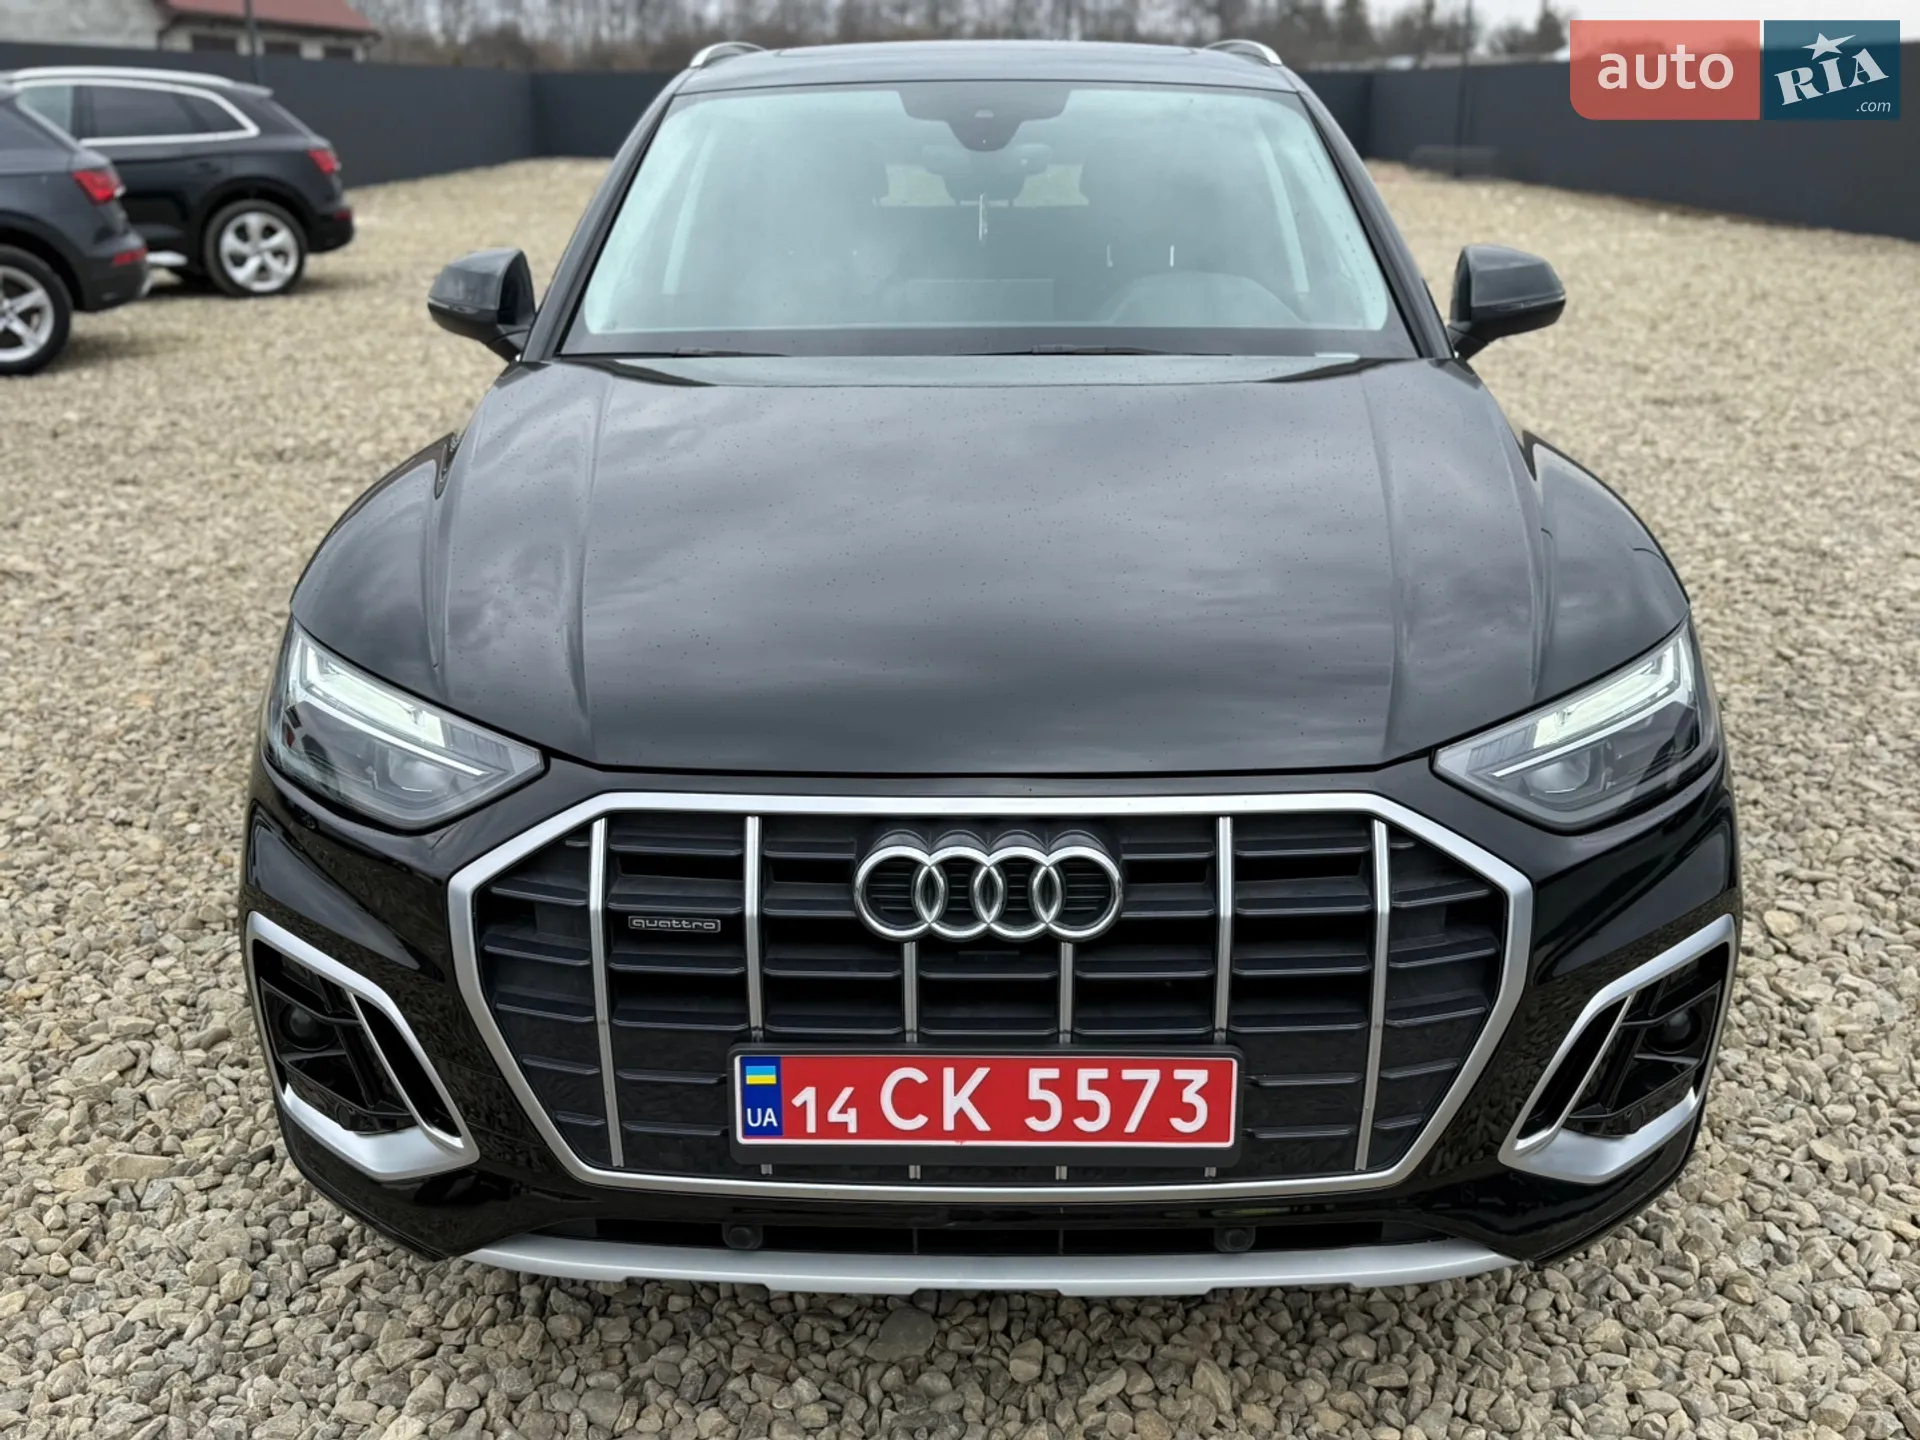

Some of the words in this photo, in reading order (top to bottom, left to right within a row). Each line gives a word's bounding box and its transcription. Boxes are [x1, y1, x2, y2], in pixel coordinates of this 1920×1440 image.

[632, 918, 716, 930] quattro
[791, 1086, 858, 1134] 14
[879, 1066, 991, 1132] CK
[1024, 1068, 1210, 1134] 5573
[746, 1107, 778, 1128] UA
